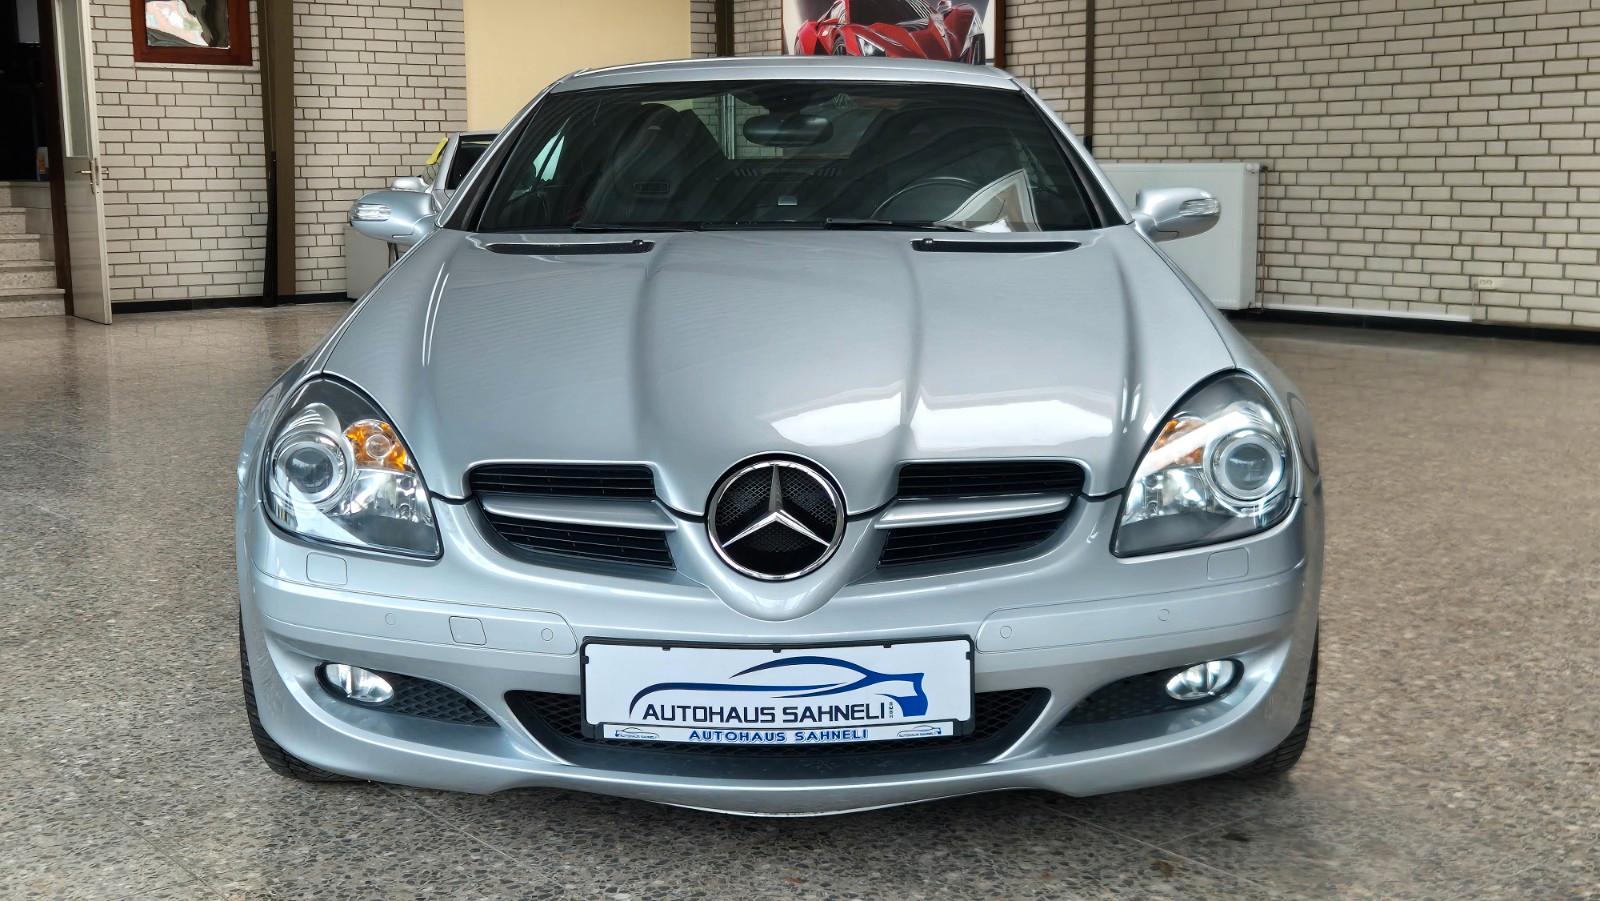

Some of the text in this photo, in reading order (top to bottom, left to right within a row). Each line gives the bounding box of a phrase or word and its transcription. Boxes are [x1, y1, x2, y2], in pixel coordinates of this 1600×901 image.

[643, 703, 776, 724] AUTOHAUS
[782, 701, 885, 723] SAHNELI
[689, 729, 868, 742] AUTOHAUS SAHNELI
